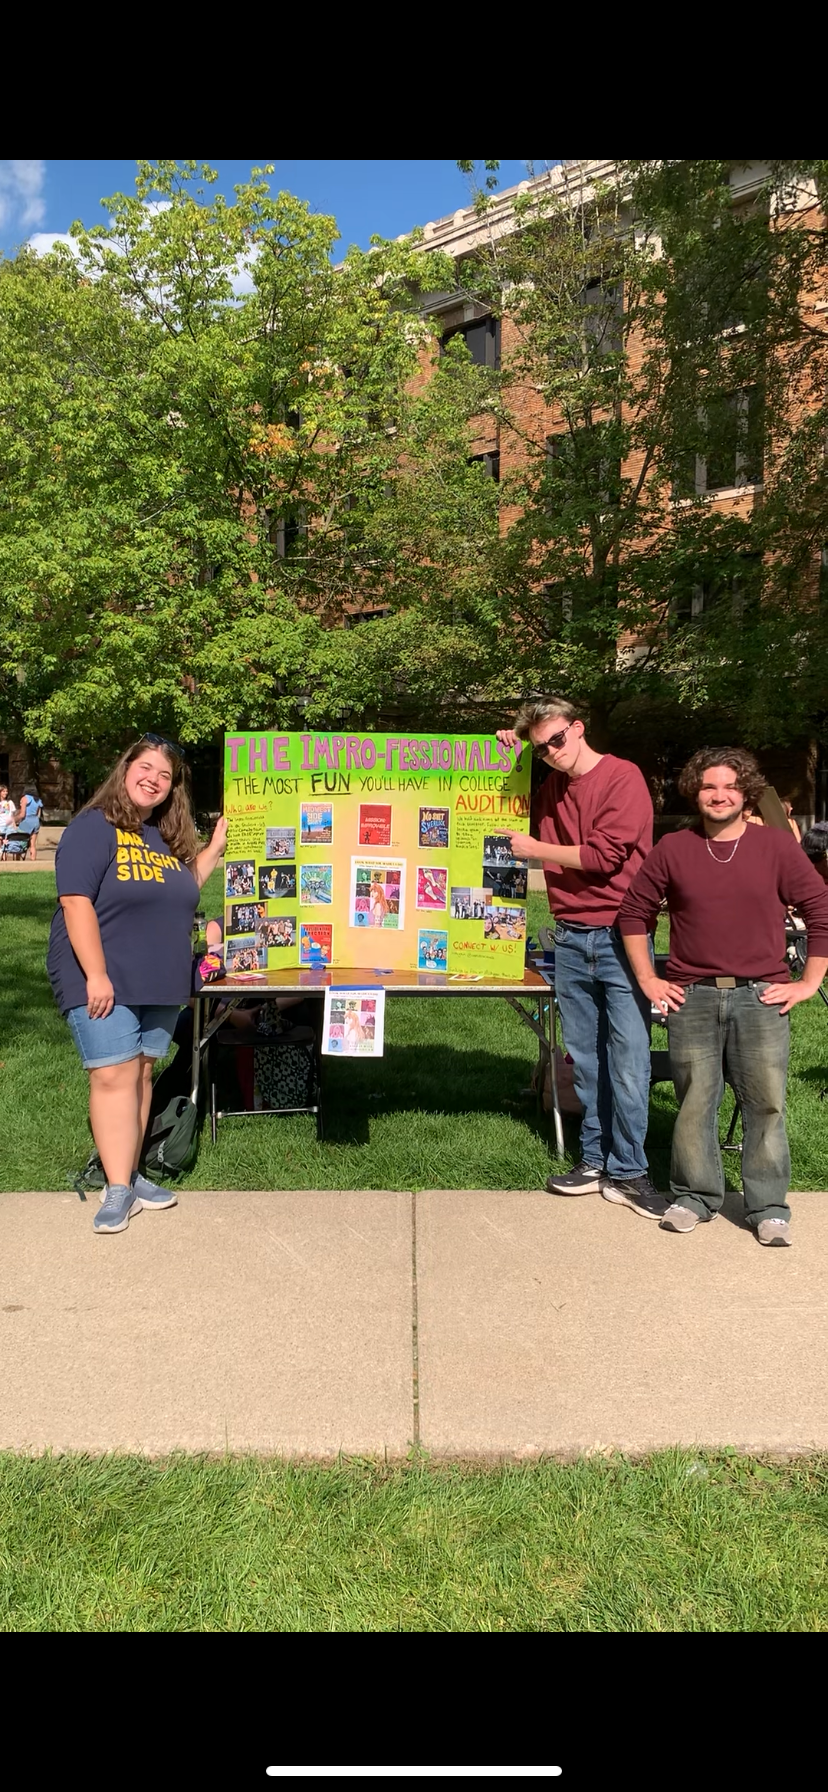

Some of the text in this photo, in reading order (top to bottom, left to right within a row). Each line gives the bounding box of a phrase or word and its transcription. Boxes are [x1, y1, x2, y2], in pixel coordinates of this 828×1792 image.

[226, 735, 522, 772] THE IMPRO-FESSIONALS!
[233, 773, 511, 795] THE MOST FUN YOU'LL HAVE IN COLLEGE
[116, 828, 150, 848] MR.
[116, 846, 181, 872] BRIGHT
[116, 864, 165, 883] SIDE
[453, 941, 486, 950] CONNECT
[502, 943, 517, 953] US!
